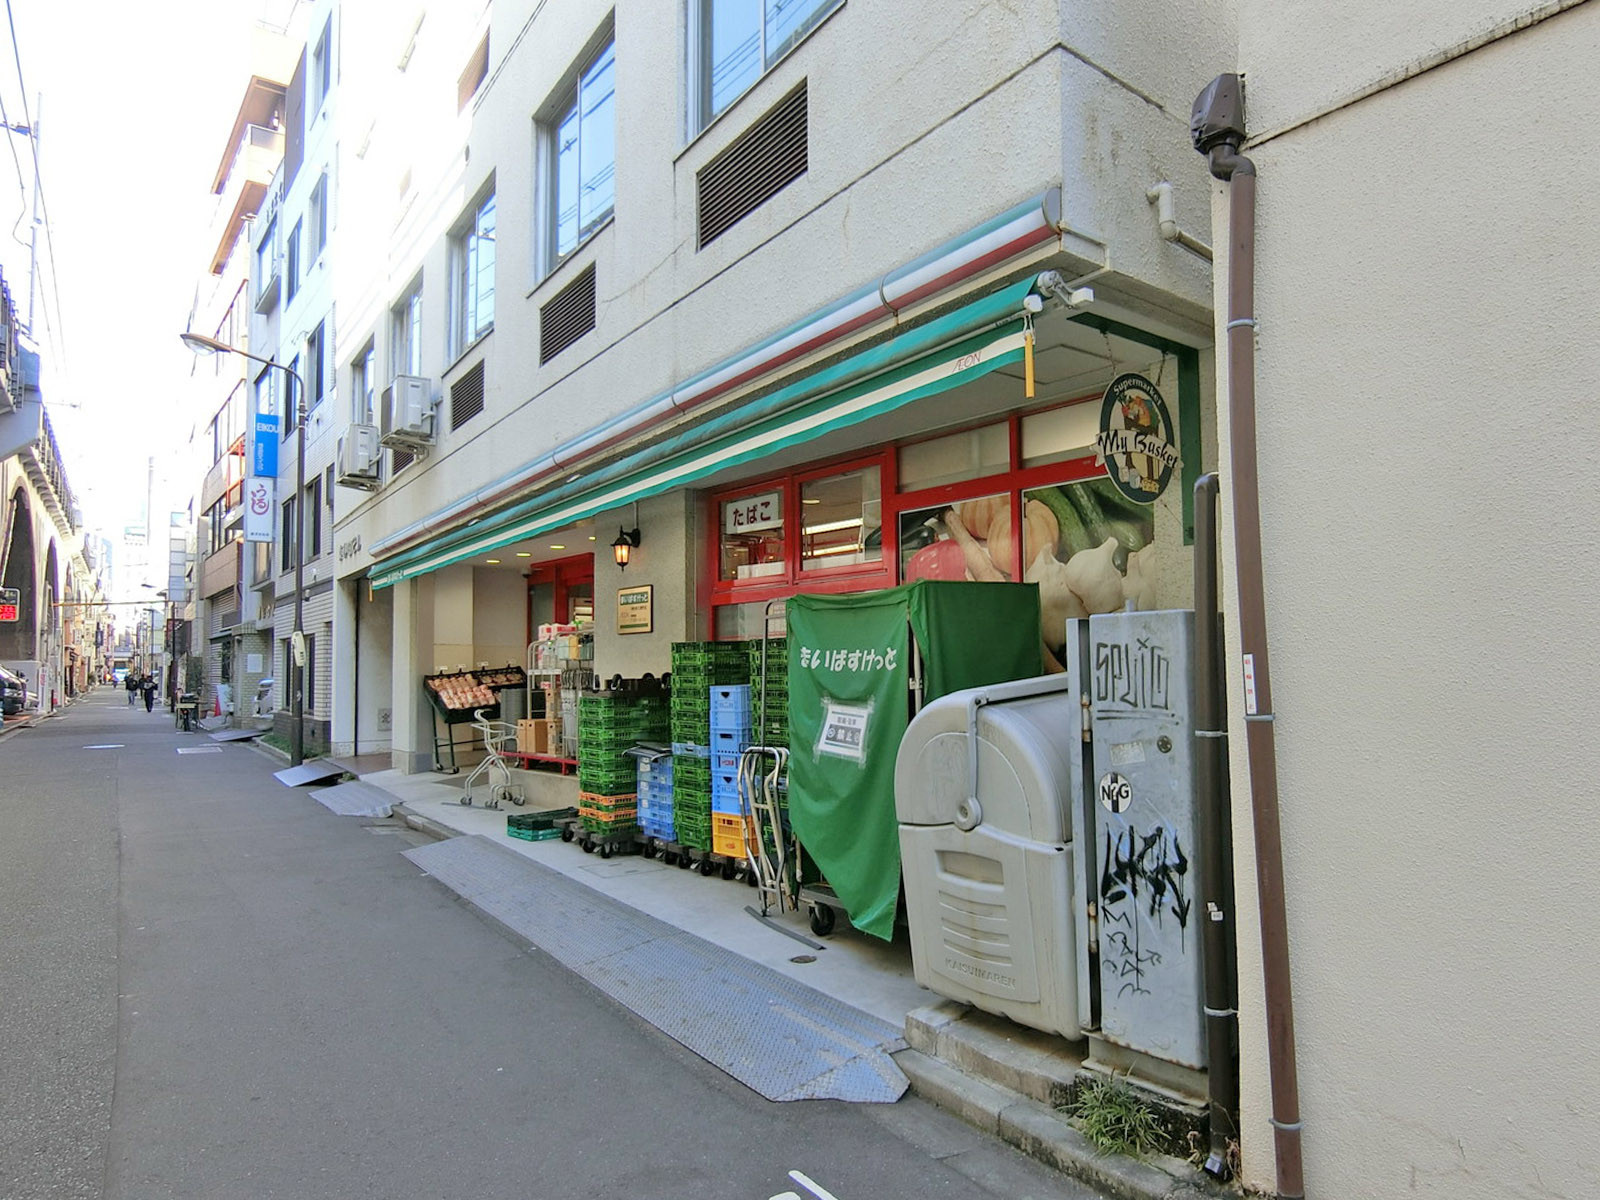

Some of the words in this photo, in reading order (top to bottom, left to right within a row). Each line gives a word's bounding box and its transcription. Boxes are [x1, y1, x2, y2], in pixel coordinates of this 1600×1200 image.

[1113, 378, 1162, 406] Supermarket
[1097, 429, 1128, 455] My
[1134, 431, 1178, 469] Basket
[732, 501, 771, 527] たばこ
[800, 646, 898, 672] まいばすけっと
